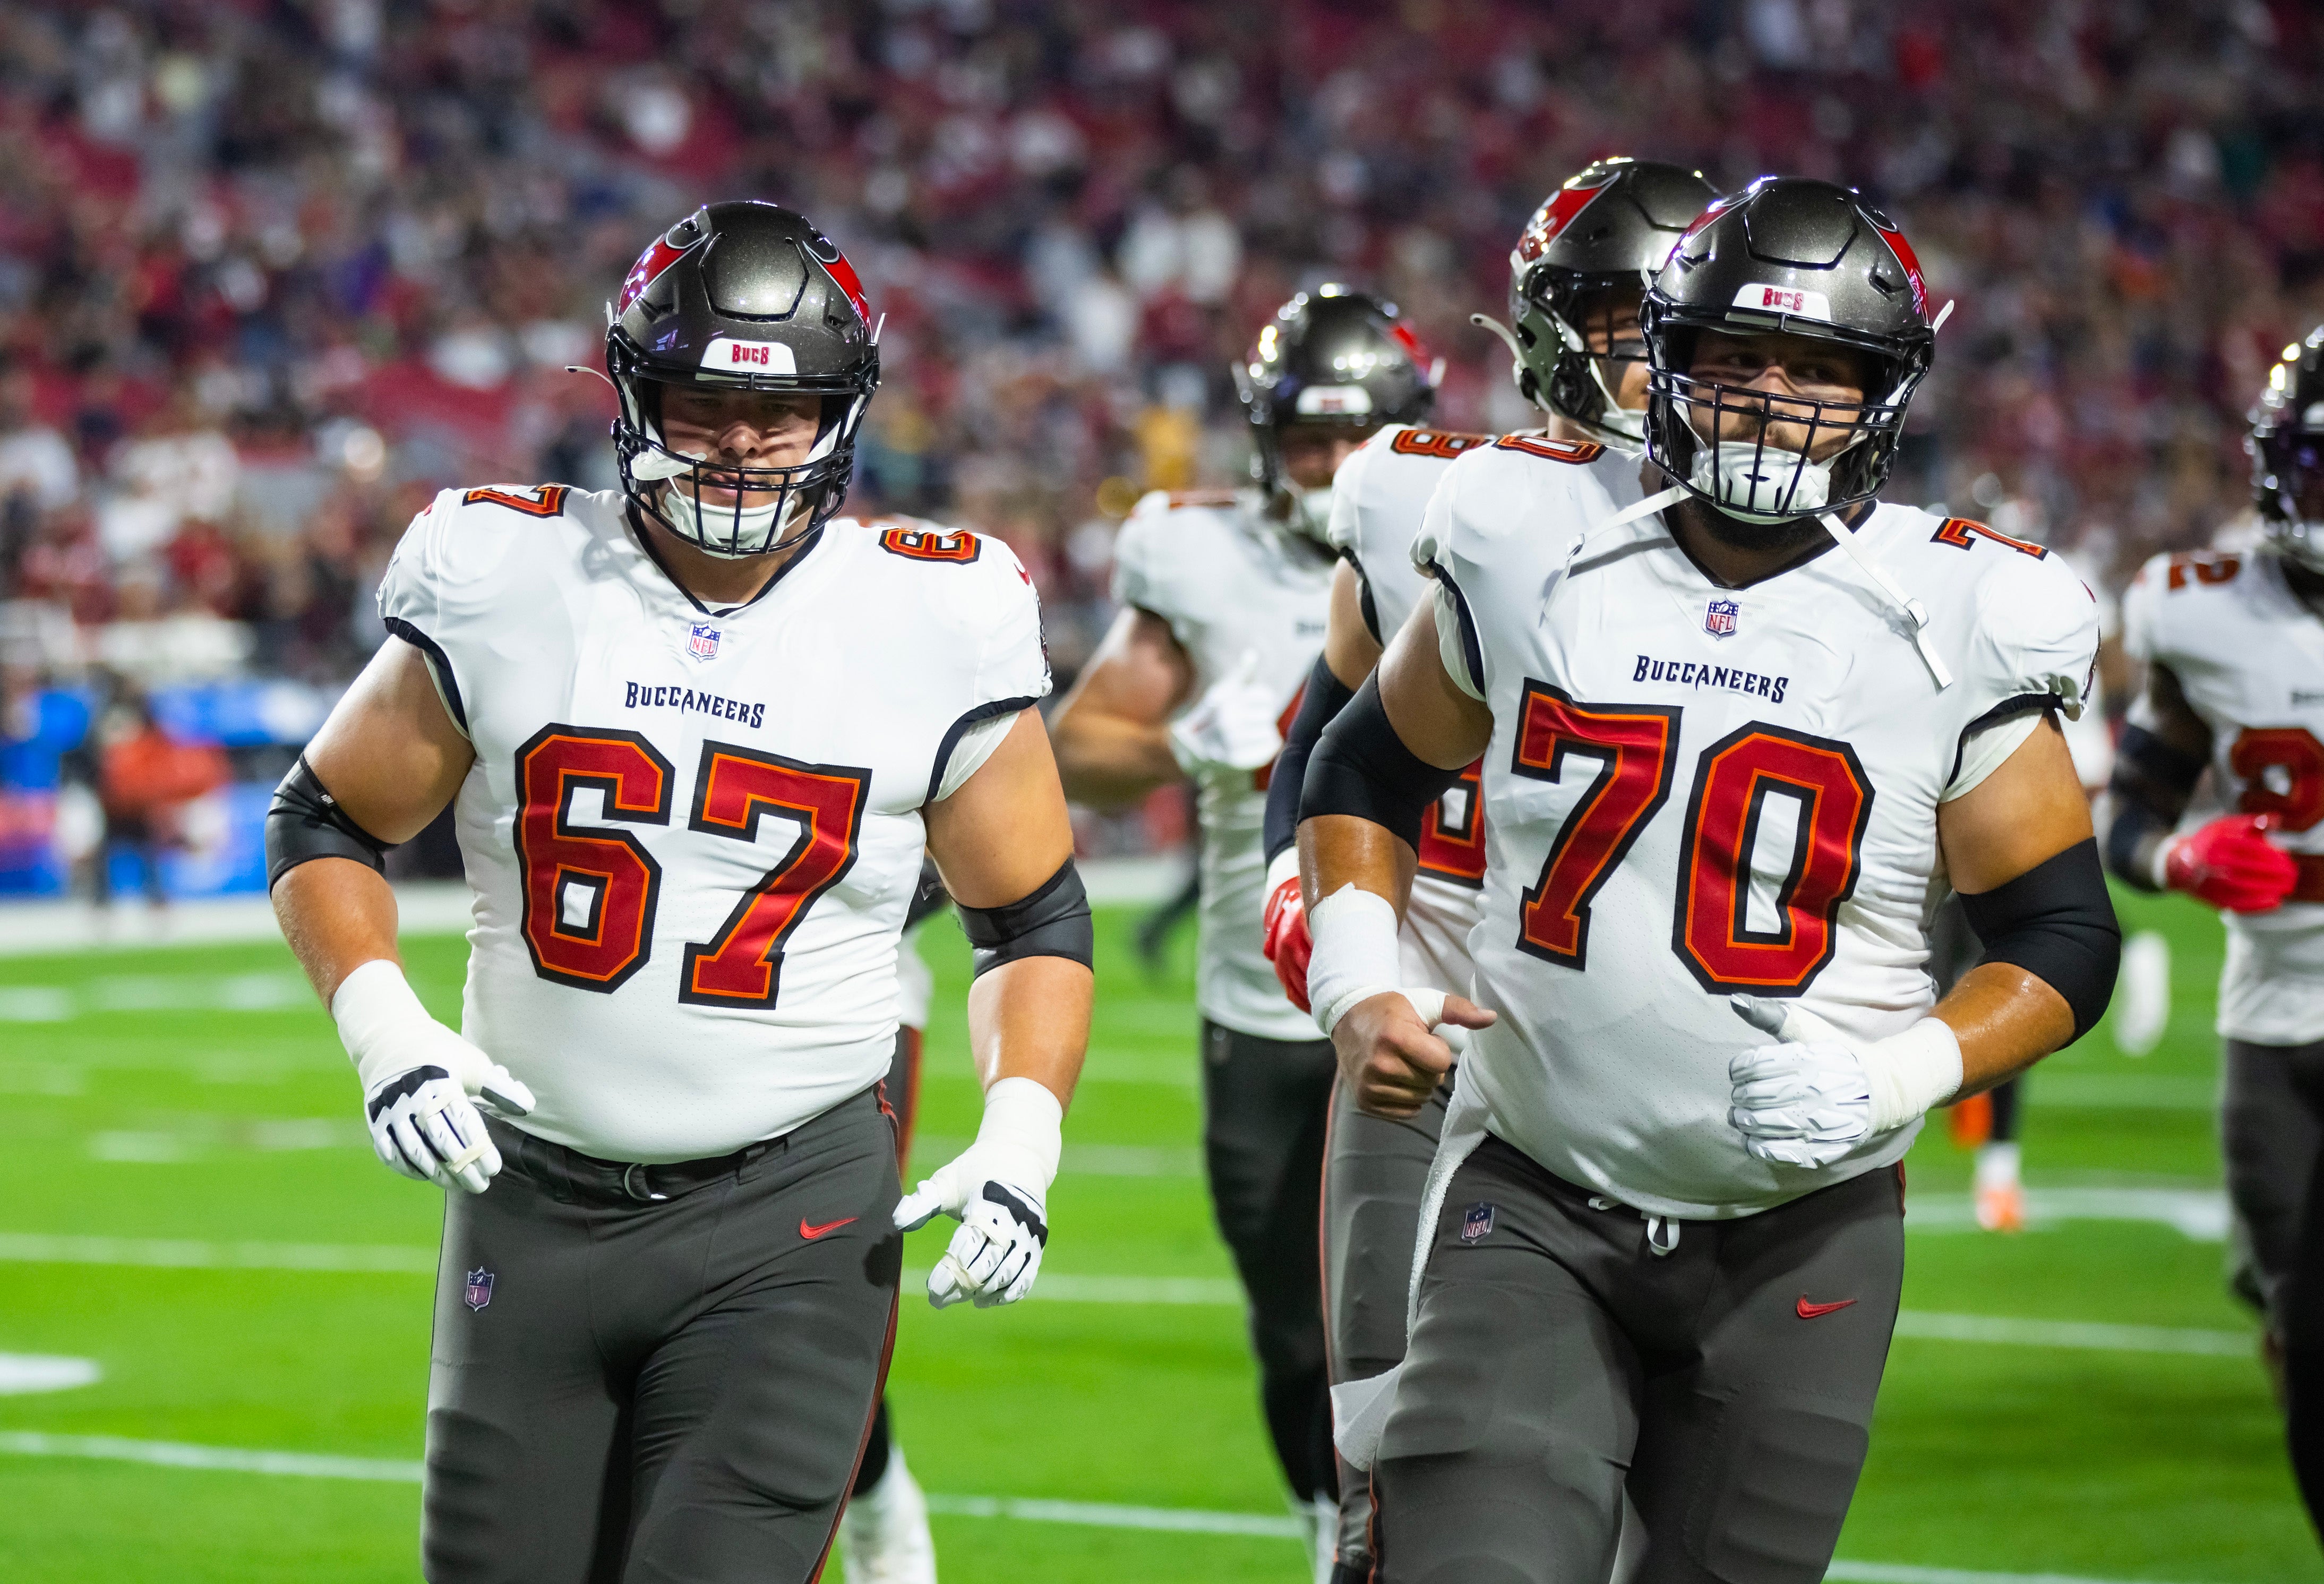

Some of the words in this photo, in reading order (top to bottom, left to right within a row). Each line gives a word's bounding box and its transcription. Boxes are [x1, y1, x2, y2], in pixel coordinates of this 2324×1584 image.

[1762, 287, 1804, 311] BUCS
[732, 344, 769, 365] BUCS
[462, 483, 571, 519] 7
[1929, 517, 2048, 562] 7
[1708, 614, 1733, 631] NFL
[691, 637, 715, 654] NFL
[1633, 654, 1789, 704] BUCCANEERS
[625, 681, 766, 729] BUCCANEERS
[1511, 677, 1876, 998] 70
[512, 722, 873, 1010] 67
